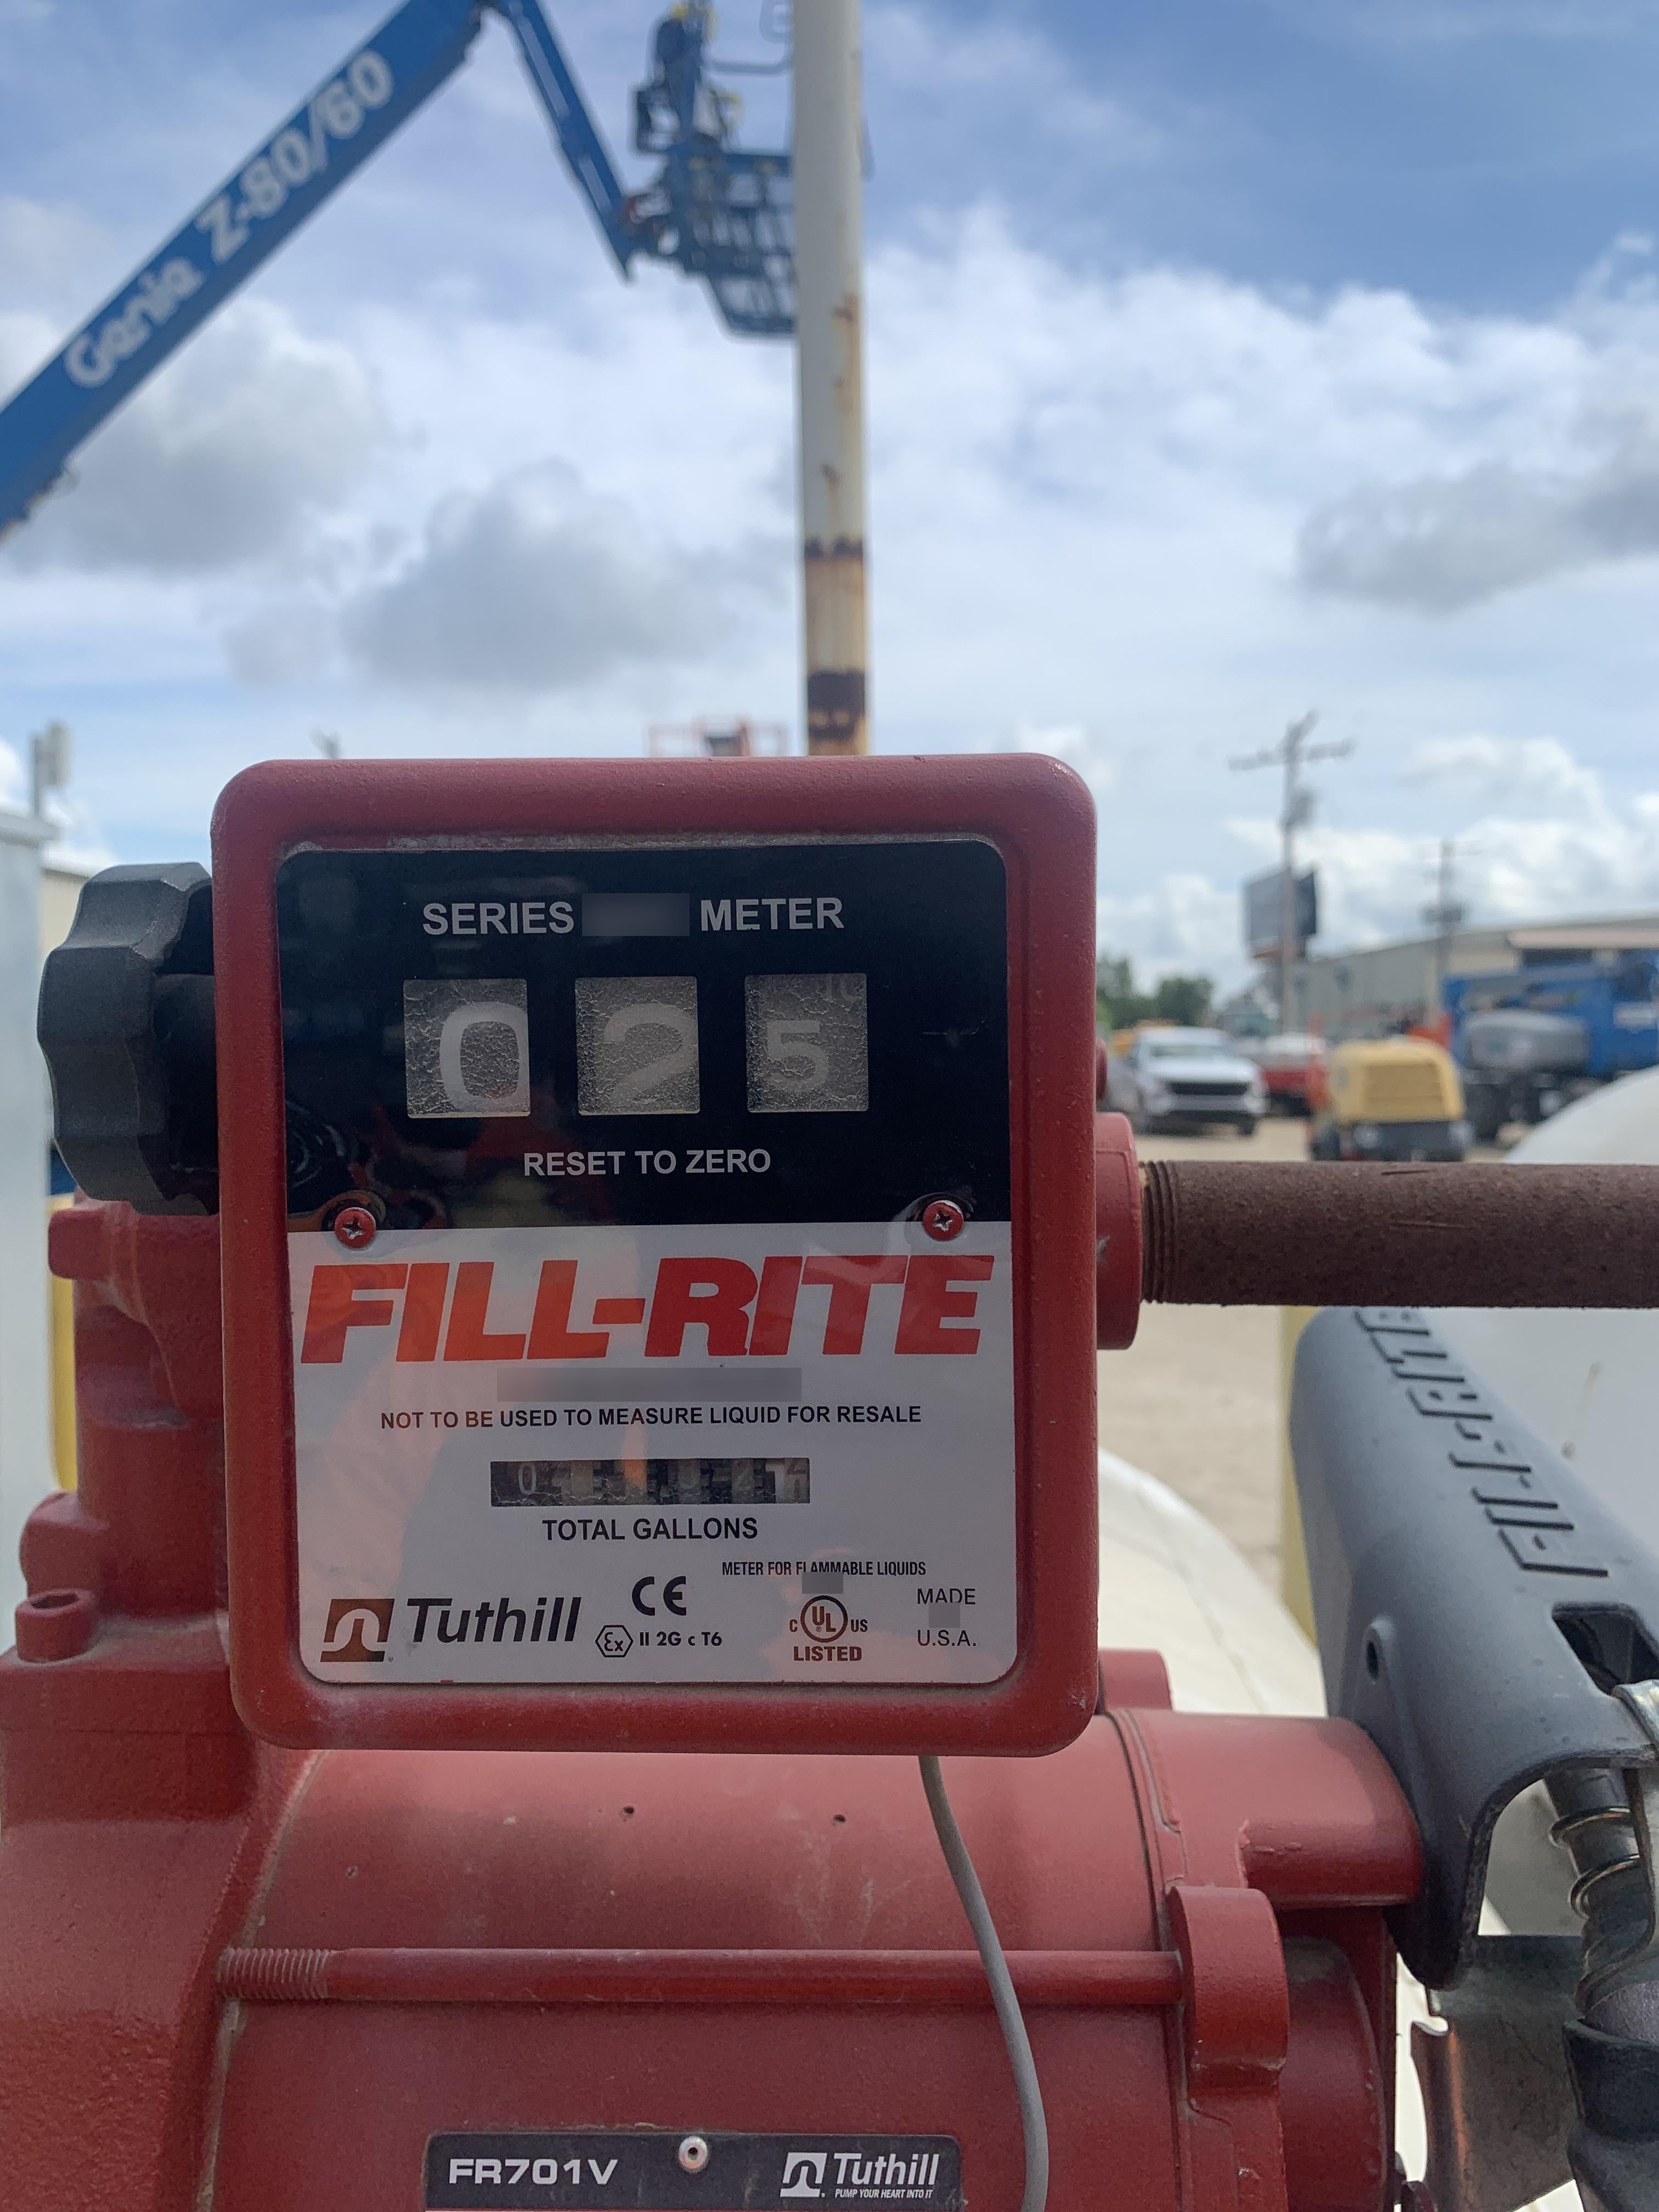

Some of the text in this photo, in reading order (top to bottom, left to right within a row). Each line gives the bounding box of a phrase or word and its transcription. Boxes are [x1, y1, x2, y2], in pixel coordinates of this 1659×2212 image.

[195, 48, 393, 262] Z-80/60
[422, 901, 574, 935] SERIES
[700, 897, 844, 932] METER
[524, 1148, 771, 1176] RESET TO ZERO
[301, 1255, 995, 1364] FILL-RITE
[381, 1406, 922, 1429] NOT TO BE USED TO MEASURE LIQUID FOR RESALE
[542, 1517, 758, 1541] TOTAL GALLONS
[722, 1561, 927, 1576] METER FOR FLAMMABLE LIQUIDS
[631, 1576, 687, 1616] CE
[917, 1588, 976, 1605] MADE
[407, 1596, 582, 1644] Tuthill
[656, 1631, 681, 1646] 2G
[701, 1631, 723, 1646] T6
[917, 1629, 977, 1647] U.S.A.
[793, 1645, 862, 1662] LISTED
[448, 2158, 619, 2185] FR701V
[833, 2152, 940, 2186] Tuthill
[834, 2188, 934, 2199] PUMP YOUR HEART INTO IT
